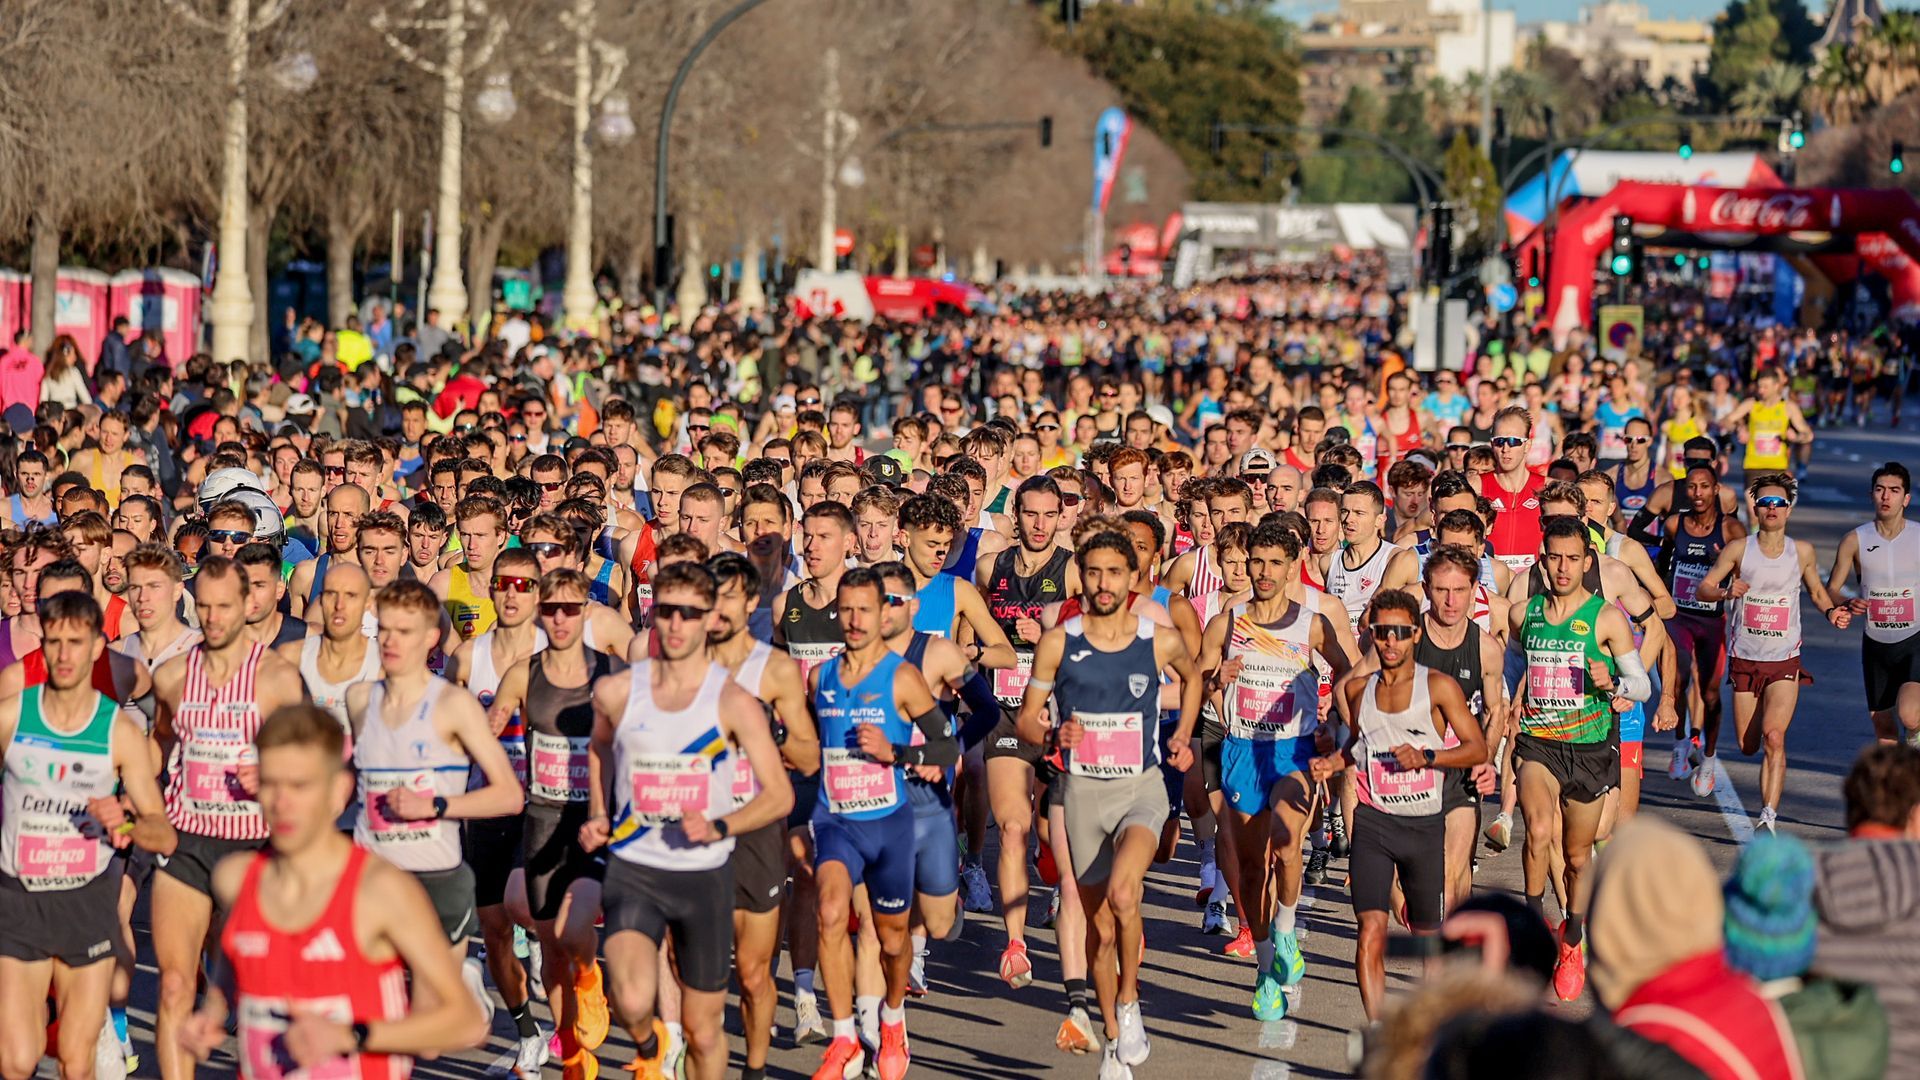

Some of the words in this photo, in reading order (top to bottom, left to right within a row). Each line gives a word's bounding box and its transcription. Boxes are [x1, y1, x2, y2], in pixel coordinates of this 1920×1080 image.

[1869, 590, 1898, 598] Ibercaja
[1746, 596, 1775, 605] Ibercaja
[1754, 613, 1779, 623] JONAS
[1874, 621, 1910, 629] KIPRUN
[1747, 628, 1784, 638] KIPRUN
[1526, 635, 1586, 651] Huesca
[1530, 655, 1562, 664] Ibercaja
[1238, 676, 1275, 688] Ibercaja
[1533, 677, 1541, 686] EL
[1243, 698, 1285, 713] MUSTAFA
[849, 708, 885, 717] AUTICA
[1079, 718, 1118, 728] bercaja
[1240, 718, 1286, 732] KIPRUN
[1081, 764, 1134, 775] KIPRUN
[834, 773, 885, 789] GIUSEPPE
[1381, 768, 1427, 784] FREEDOM
[838, 797, 890, 811] KIPRUN
[1380, 791, 1431, 805] KIPRUN
[21, 794, 89, 817] Cetila
[21, 821, 71, 834] Ibercaja
[28, 847, 87, 865] LORENZO
